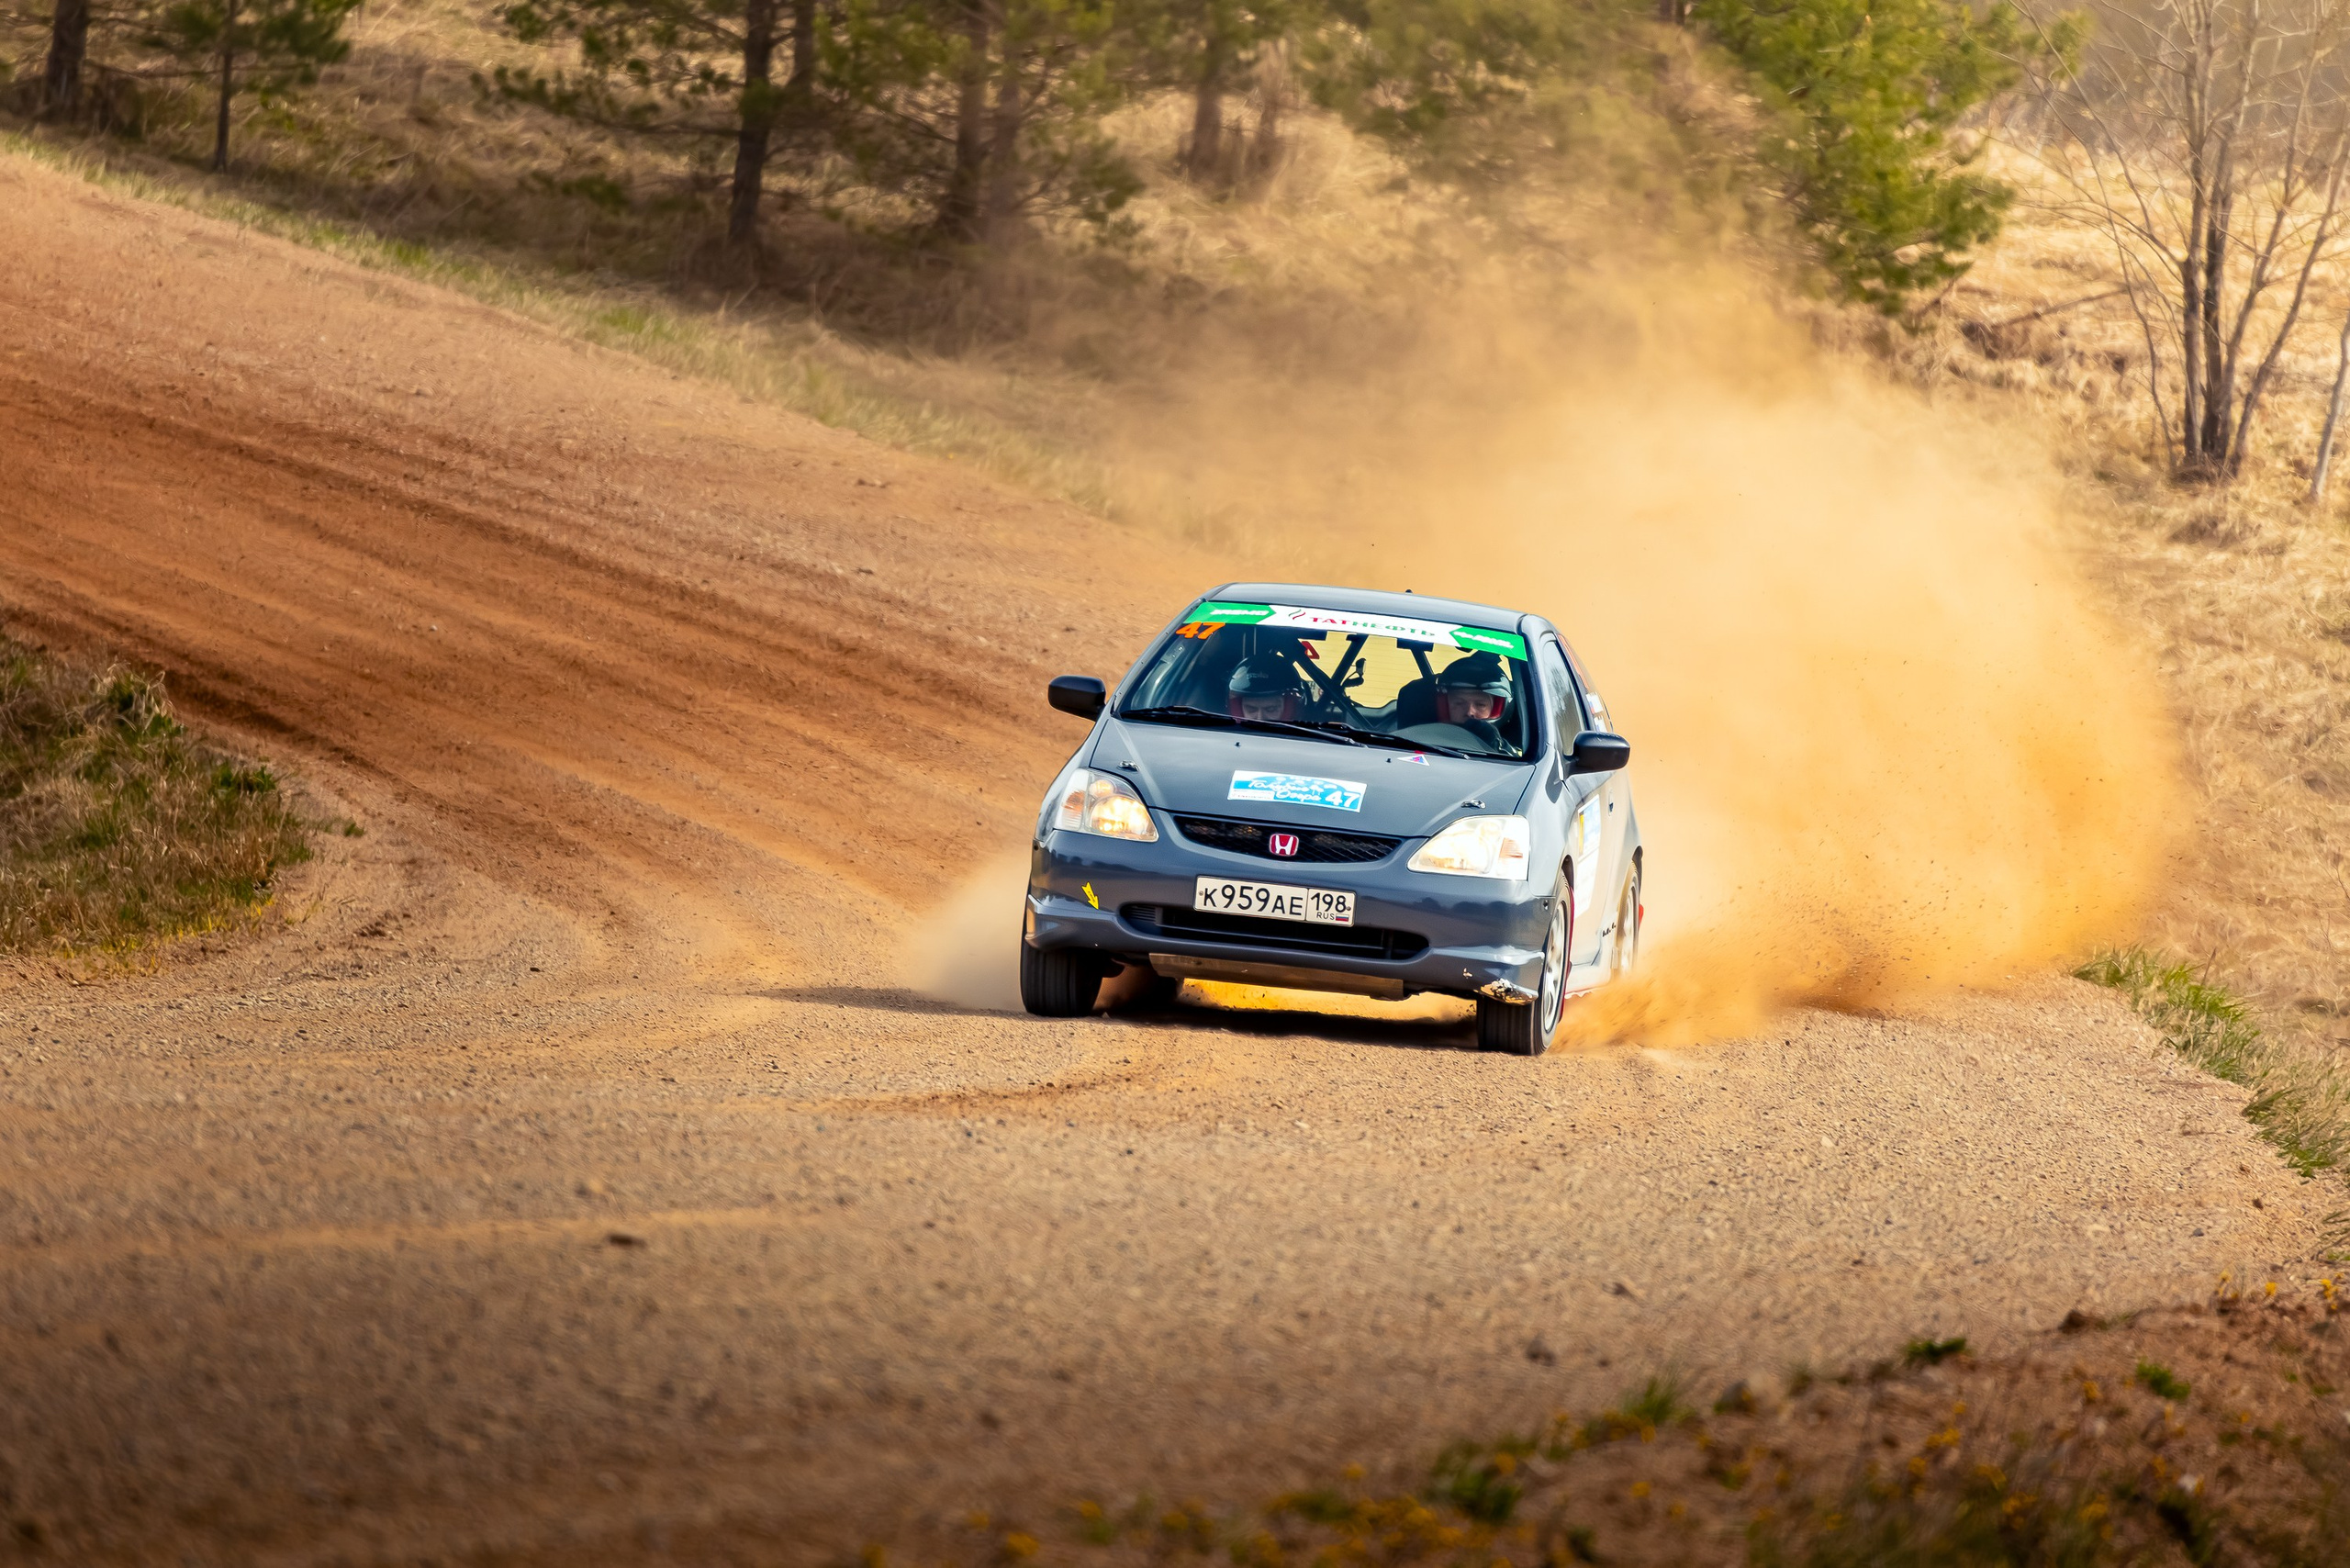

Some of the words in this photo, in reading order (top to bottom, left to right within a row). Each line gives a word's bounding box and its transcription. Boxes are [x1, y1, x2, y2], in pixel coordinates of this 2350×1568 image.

[1175, 621, 1226, 640] 47
[1310, 617, 1436, 636] ТАТНЕФТЬ
[1325, 790, 1360, 808] 47
[1203, 884, 1304, 916] К959АЕ
[1310, 892, 1347, 913] 198
[1315, 911, 1335, 921] RUS
